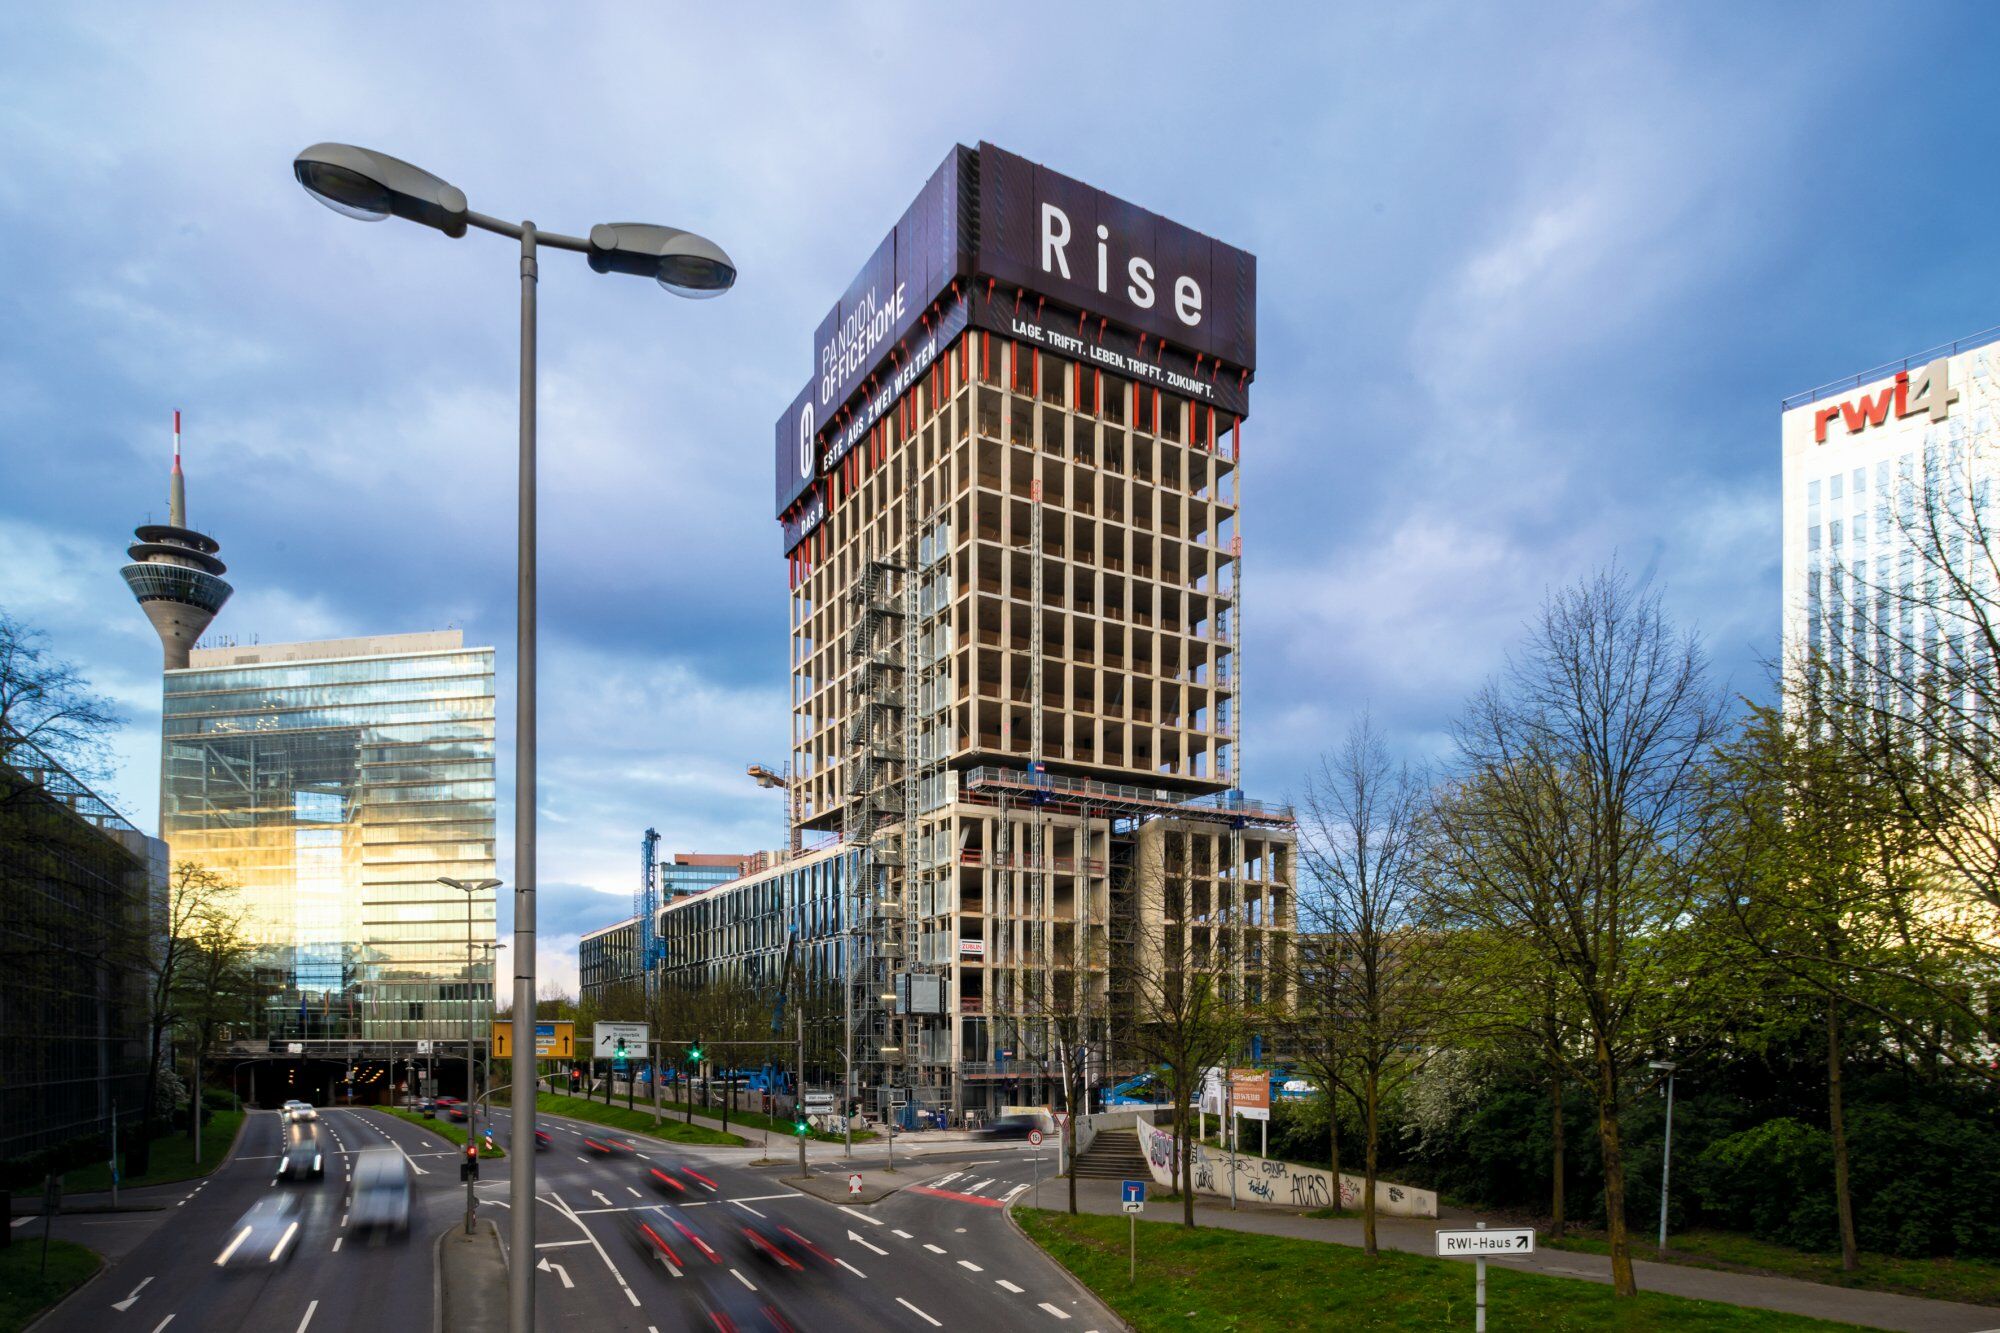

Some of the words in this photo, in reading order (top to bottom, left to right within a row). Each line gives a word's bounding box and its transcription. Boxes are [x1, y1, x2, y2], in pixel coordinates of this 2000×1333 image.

[1042, 202, 1202, 327] Rise
[822, 286, 876, 377] PANDION
[822, 282, 906, 406] OFFICEHOME
[1012, 318, 1045, 342] LAGE.
[1047, 330, 1087, 356] TRIFFT.
[1090, 345, 1126, 369] LEBEN.
[1127, 357, 1164, 382] TRIFFT.
[1167, 371, 1214, 399] ZUKUNFT.
[801, 510, 815, 536] DAS
[847, 416, 864, 446] AUS
[868, 386, 892, 425] ZWEI
[894, 338, 936, 395] WELTEN
[1447, 1237, 1511, 1250] RWI-Haus
